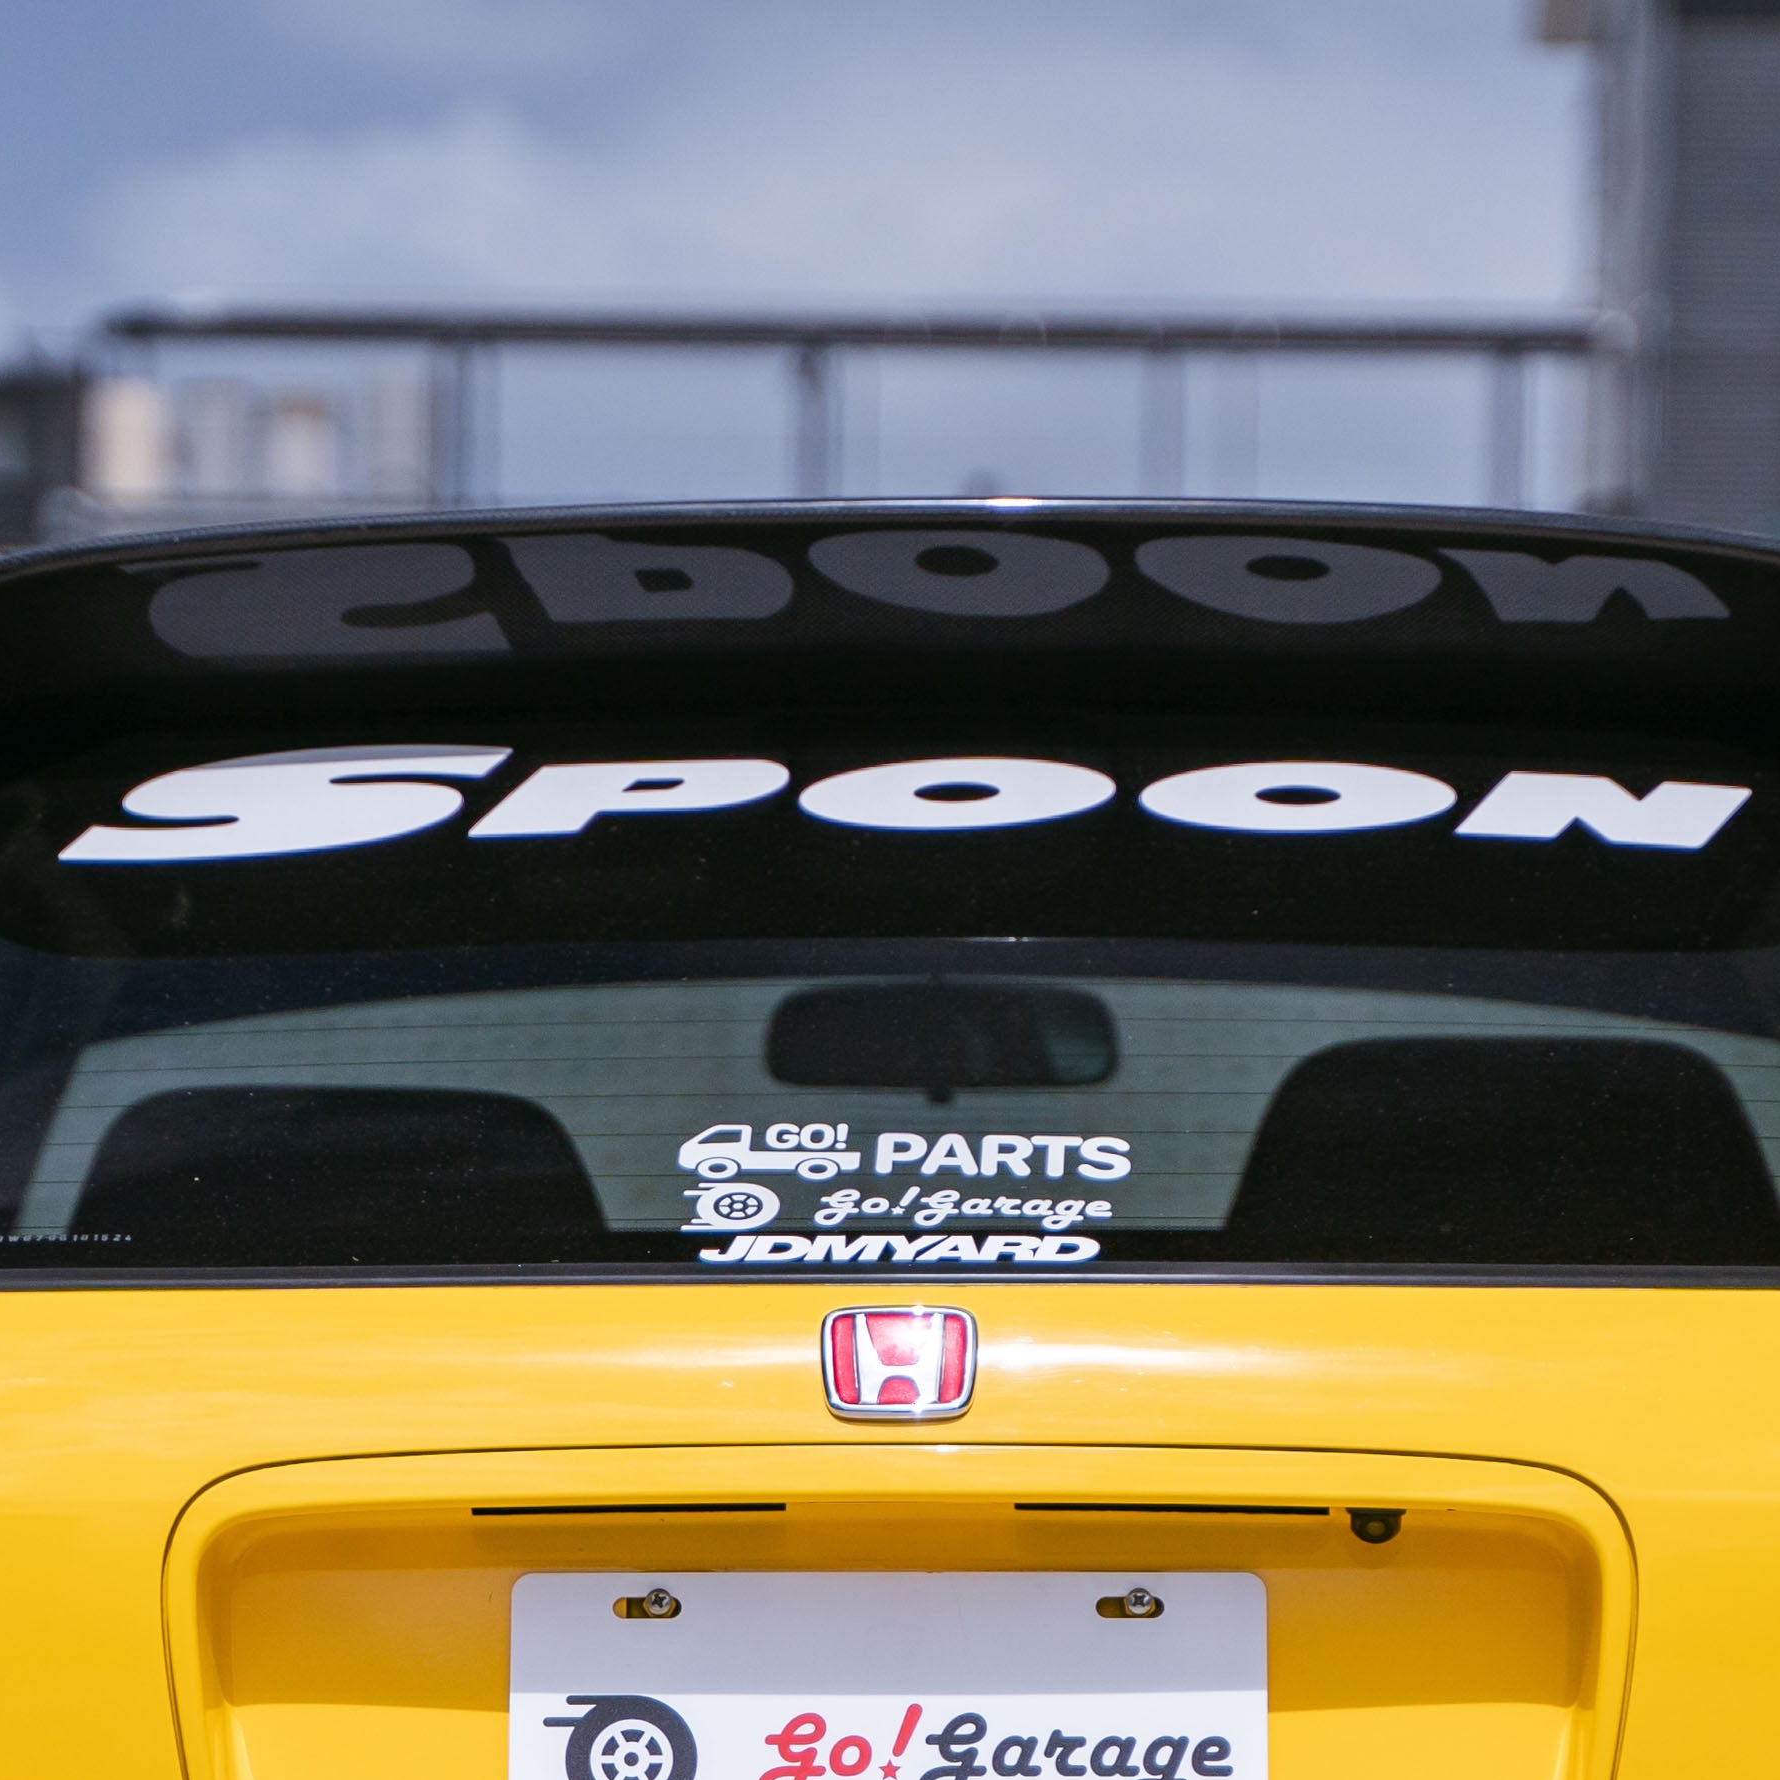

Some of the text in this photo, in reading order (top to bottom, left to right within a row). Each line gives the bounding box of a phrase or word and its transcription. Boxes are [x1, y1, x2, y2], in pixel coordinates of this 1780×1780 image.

[764, 1122, 850, 1151] GO!
[873, 1131, 1133, 1180] PARTS
[697, 1234, 1102, 1263] JDMYARD
